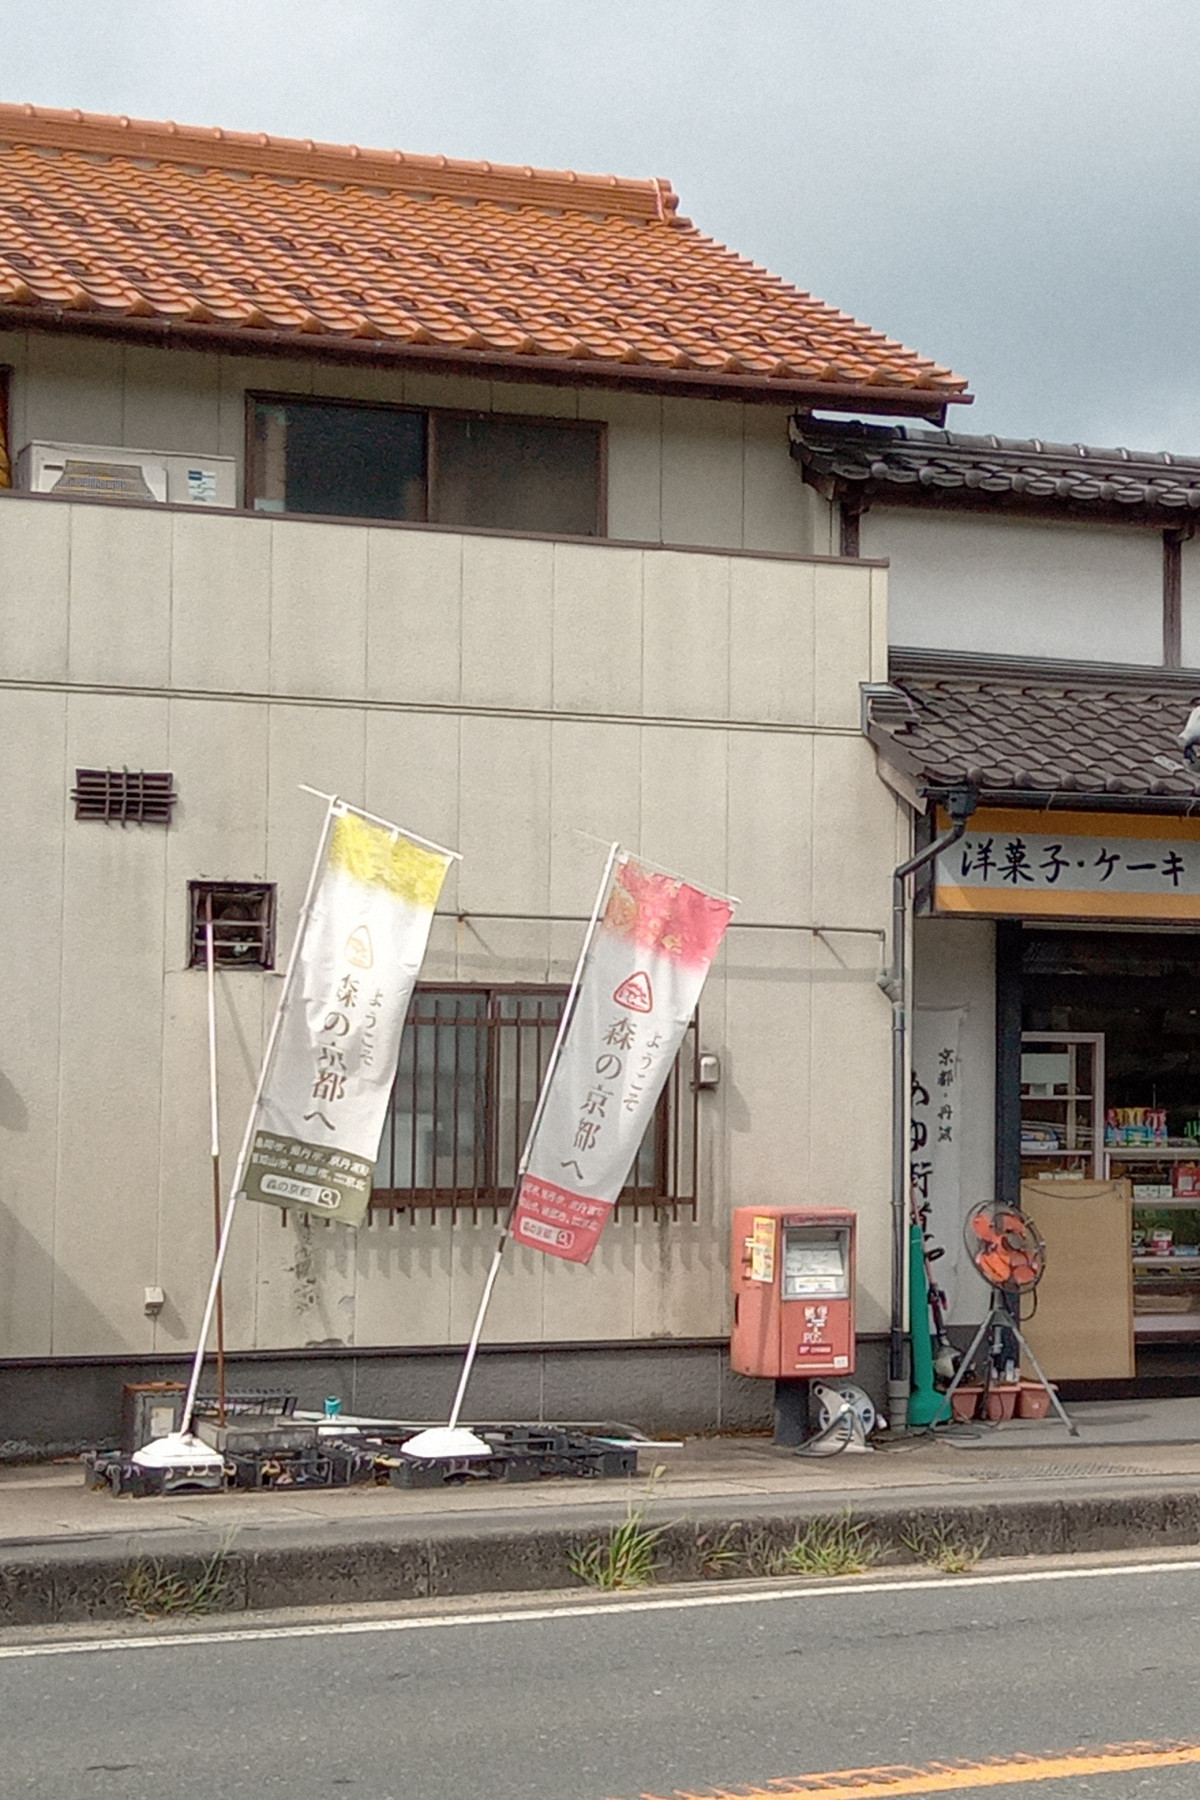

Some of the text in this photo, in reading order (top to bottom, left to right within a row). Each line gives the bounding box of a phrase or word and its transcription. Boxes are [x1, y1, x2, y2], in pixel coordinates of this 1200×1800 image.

[961, 838, 1186, 887] 洋菓子・ケーキ
[560, 1016, 638, 1180] 森の京都へ
[623, 1032, 663, 1113] ようこそ
